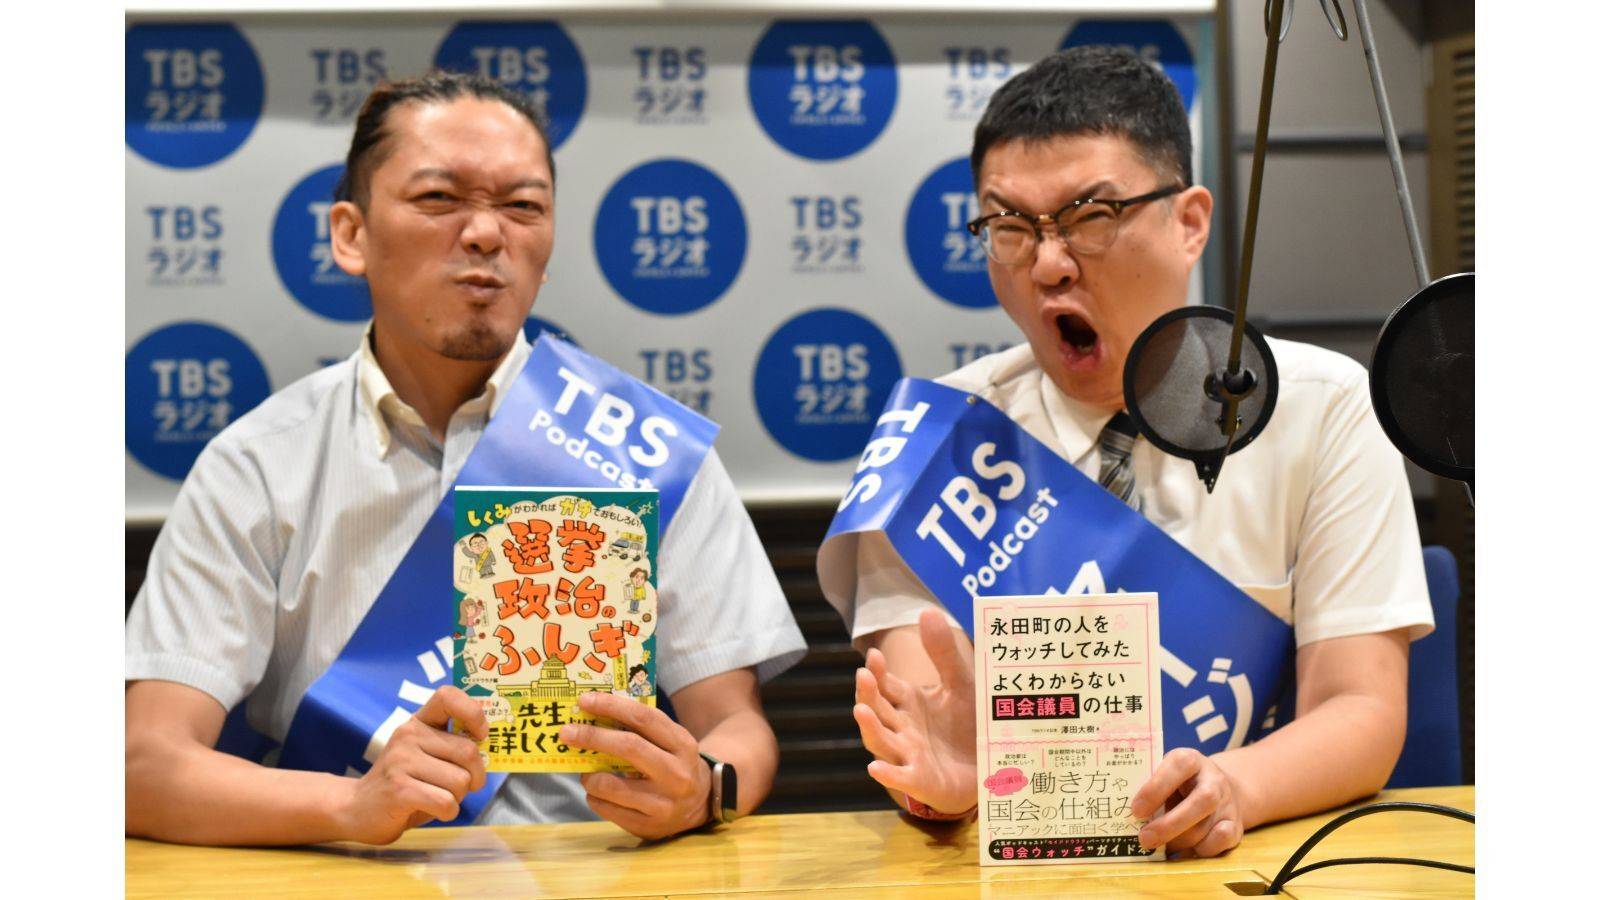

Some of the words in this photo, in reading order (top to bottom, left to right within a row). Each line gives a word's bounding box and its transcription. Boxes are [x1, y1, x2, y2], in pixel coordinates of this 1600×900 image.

[143, 49, 225, 87] TBS
[311, 49, 387, 84] TBS
[472, 46, 549, 83] TBS
[633, 47, 707, 81] TBS
[789, 46, 865, 83] TBS
[943, 47, 1012, 79] TBS
[144, 90, 224, 122] ラジオ
[636, 86, 707, 115] ラジオ
[790, 84, 866, 115] ラジオ
[147, 205, 223, 240] TBS
[631, 196, 709, 234] TBS
[790, 196, 862, 230] TBS
[147, 247, 222, 275] ラジオ
[632, 236, 709, 267] ラジオ
[791, 235, 862, 263] ラジオ
[152, 358, 233, 397] TBS
[640, 349, 714, 382] TBS
[795, 343, 870, 381] TBS
[153, 400, 232, 432] ラジオ
[796, 384, 870, 414] ラジオ
[553, 366, 678, 468] TBS
[528, 408, 654, 489] Podcast
[837, 400, 931, 513] TBS
[915, 441, 1026, 568] TBS
[501, 518, 606, 575] 選挙
[961, 487, 1059, 598] Podcast
[493, 576, 617, 621] 政治の
[990, 614, 1109, 636] 永田町の人を
[479, 620, 640, 677] ふしぎ
[992, 640, 1130, 661] ウォッチしてみた
[993, 671, 1125, 691] よくわからない
[995, 694, 1143, 717] 国会議員の仕事
[1029, 770, 1129, 796] 働き方や
